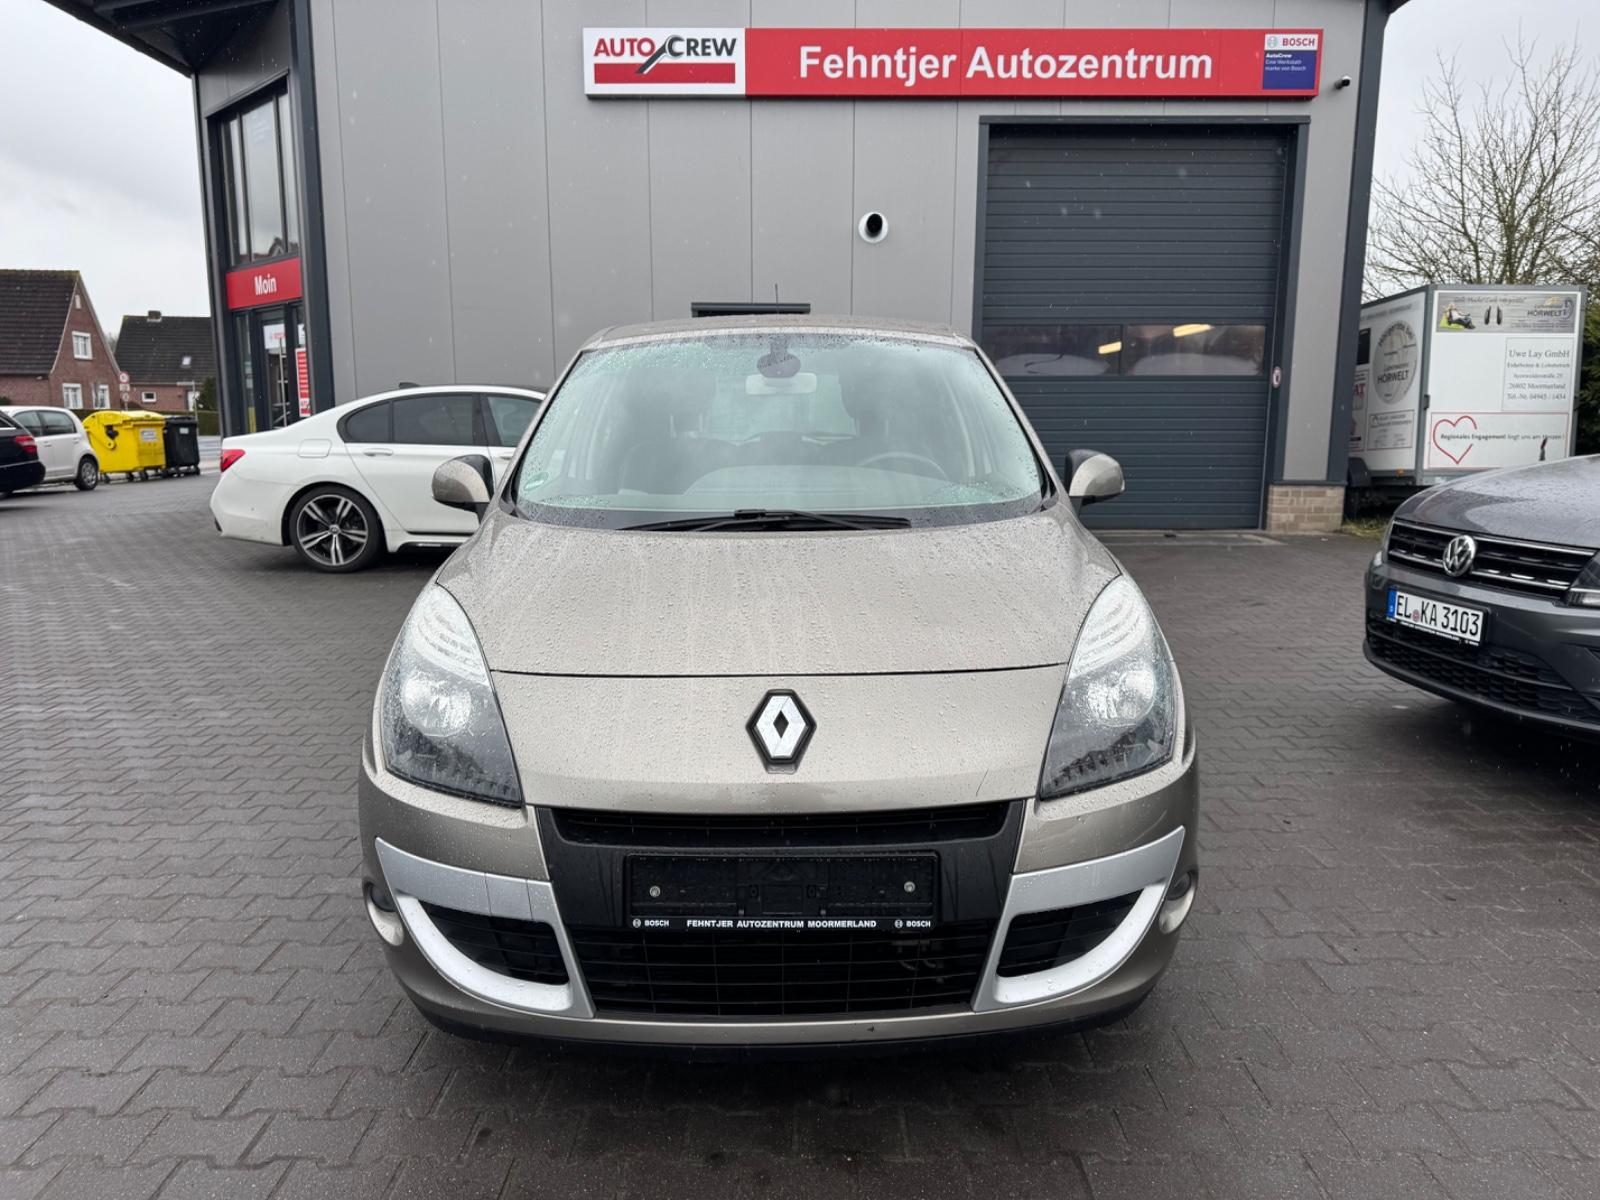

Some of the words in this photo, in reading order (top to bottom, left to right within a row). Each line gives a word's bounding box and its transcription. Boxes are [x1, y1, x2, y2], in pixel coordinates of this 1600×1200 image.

[593, 37, 656, 57] AUTO
[668, 36, 738, 57] CREW
[1282, 37, 1315, 47] BOSCH
[800, 46, 957, 86] Fehntjer
[965, 46, 1213, 79] Autozentrum
[254, 275, 276, 295] Moin
[1509, 350, 1527, 358] Uwe
[1544, 350, 1569, 358] GmbH
[1440, 433, 1471, 441] Regionales
[1471, 433, 1507, 441] Engagement
[1396, 594, 1412, 619] EL
[1421, 600, 1438, 627] KA
[1441, 606, 1481, 637] 3103
[644, 919, 670, 928] BOSCH
[686, 919, 734, 929] FEHNTJER
[736, 919, 804, 929] AUTOZENTRUM
[807, 919, 877, 928] MOORMERLAND
[905, 919, 932, 928] BOSCH
